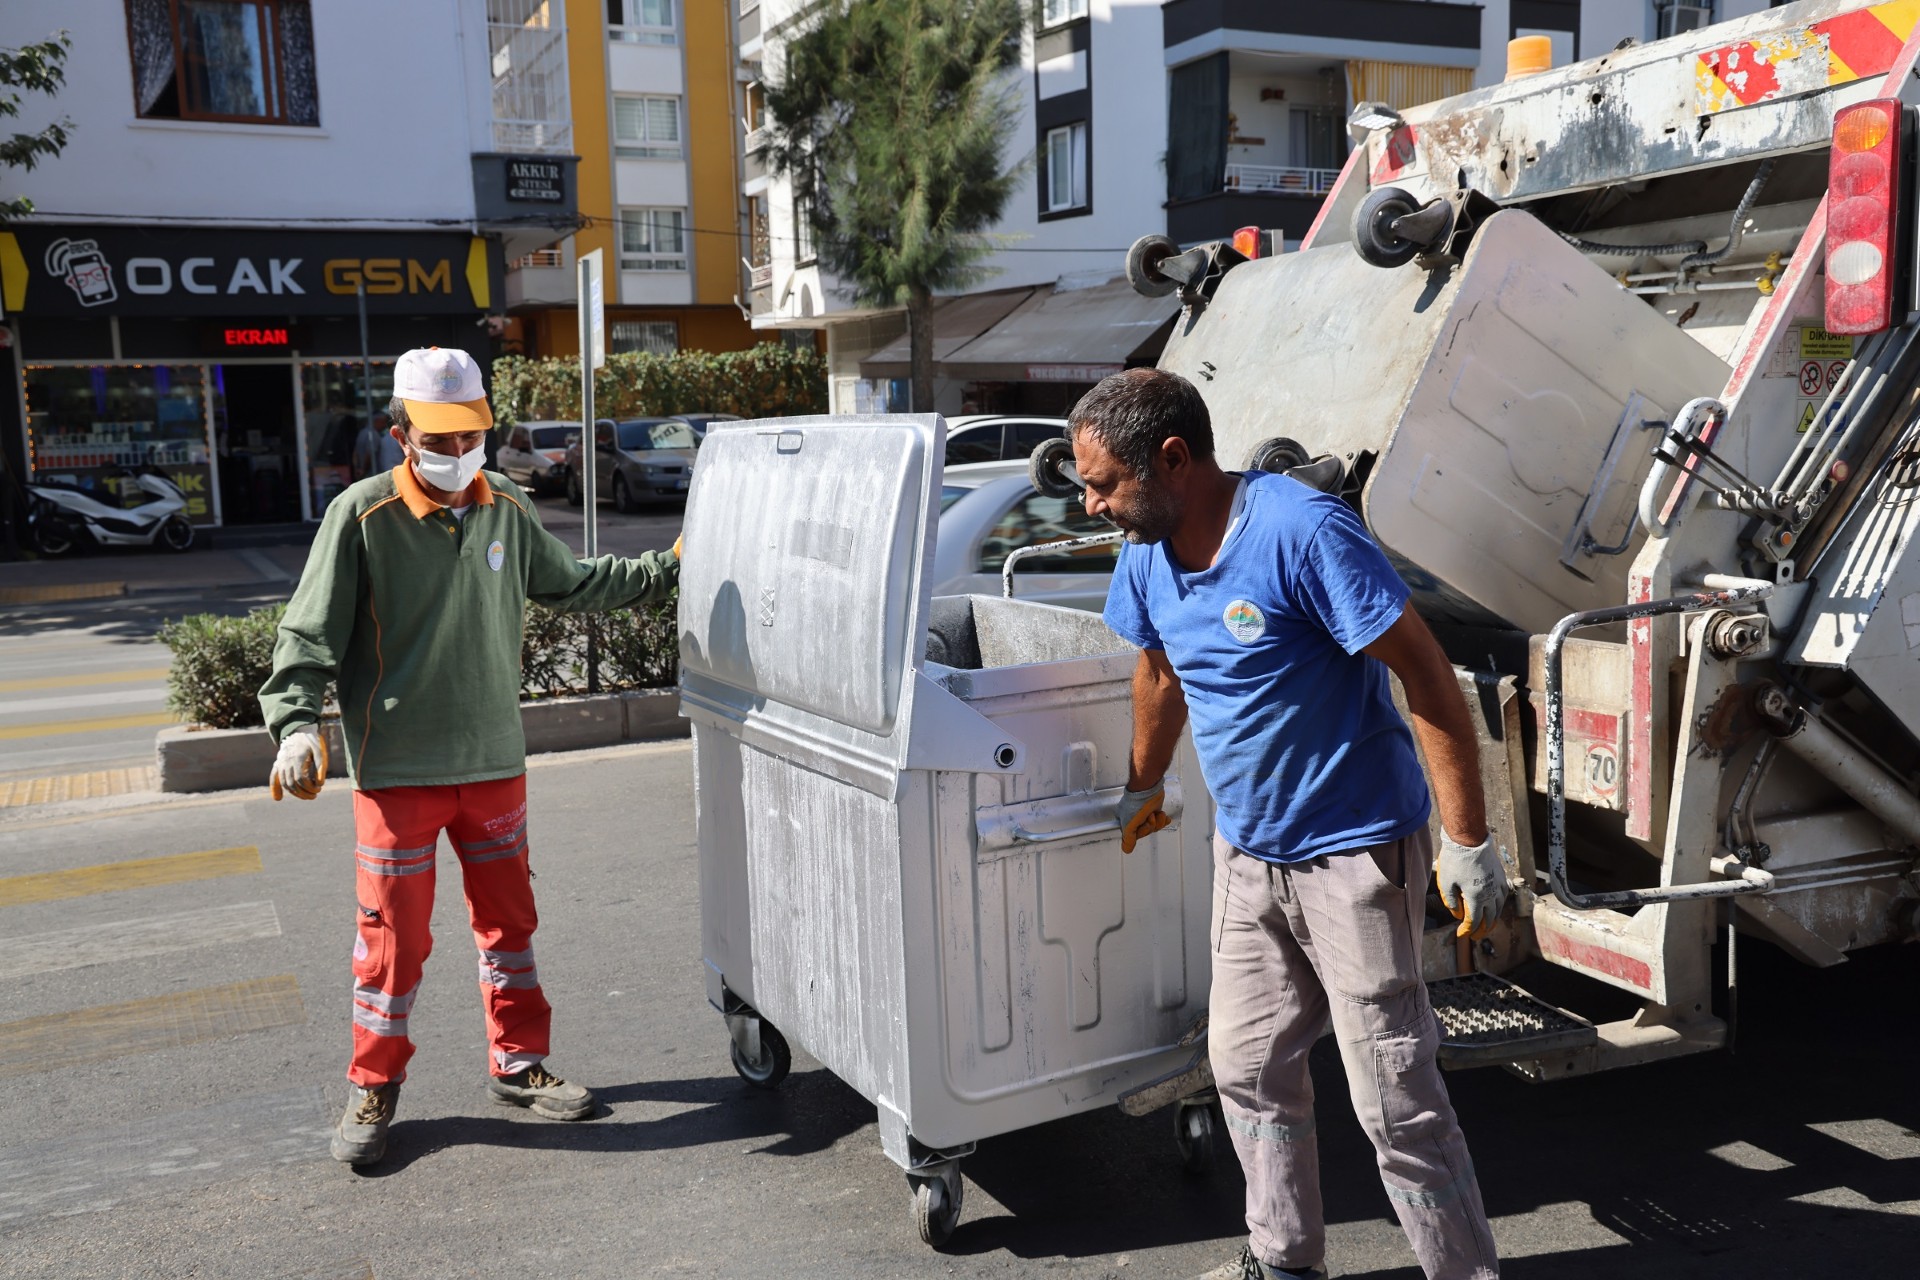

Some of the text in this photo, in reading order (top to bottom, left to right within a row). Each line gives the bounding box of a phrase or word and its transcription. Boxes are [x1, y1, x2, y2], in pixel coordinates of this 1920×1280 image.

[510, 163, 559, 179] AKKUR
[125, 257, 452, 295] OCAK GSM
[224, 328, 288, 346] EKRAN
[1590, 753, 1616, 784] 70
